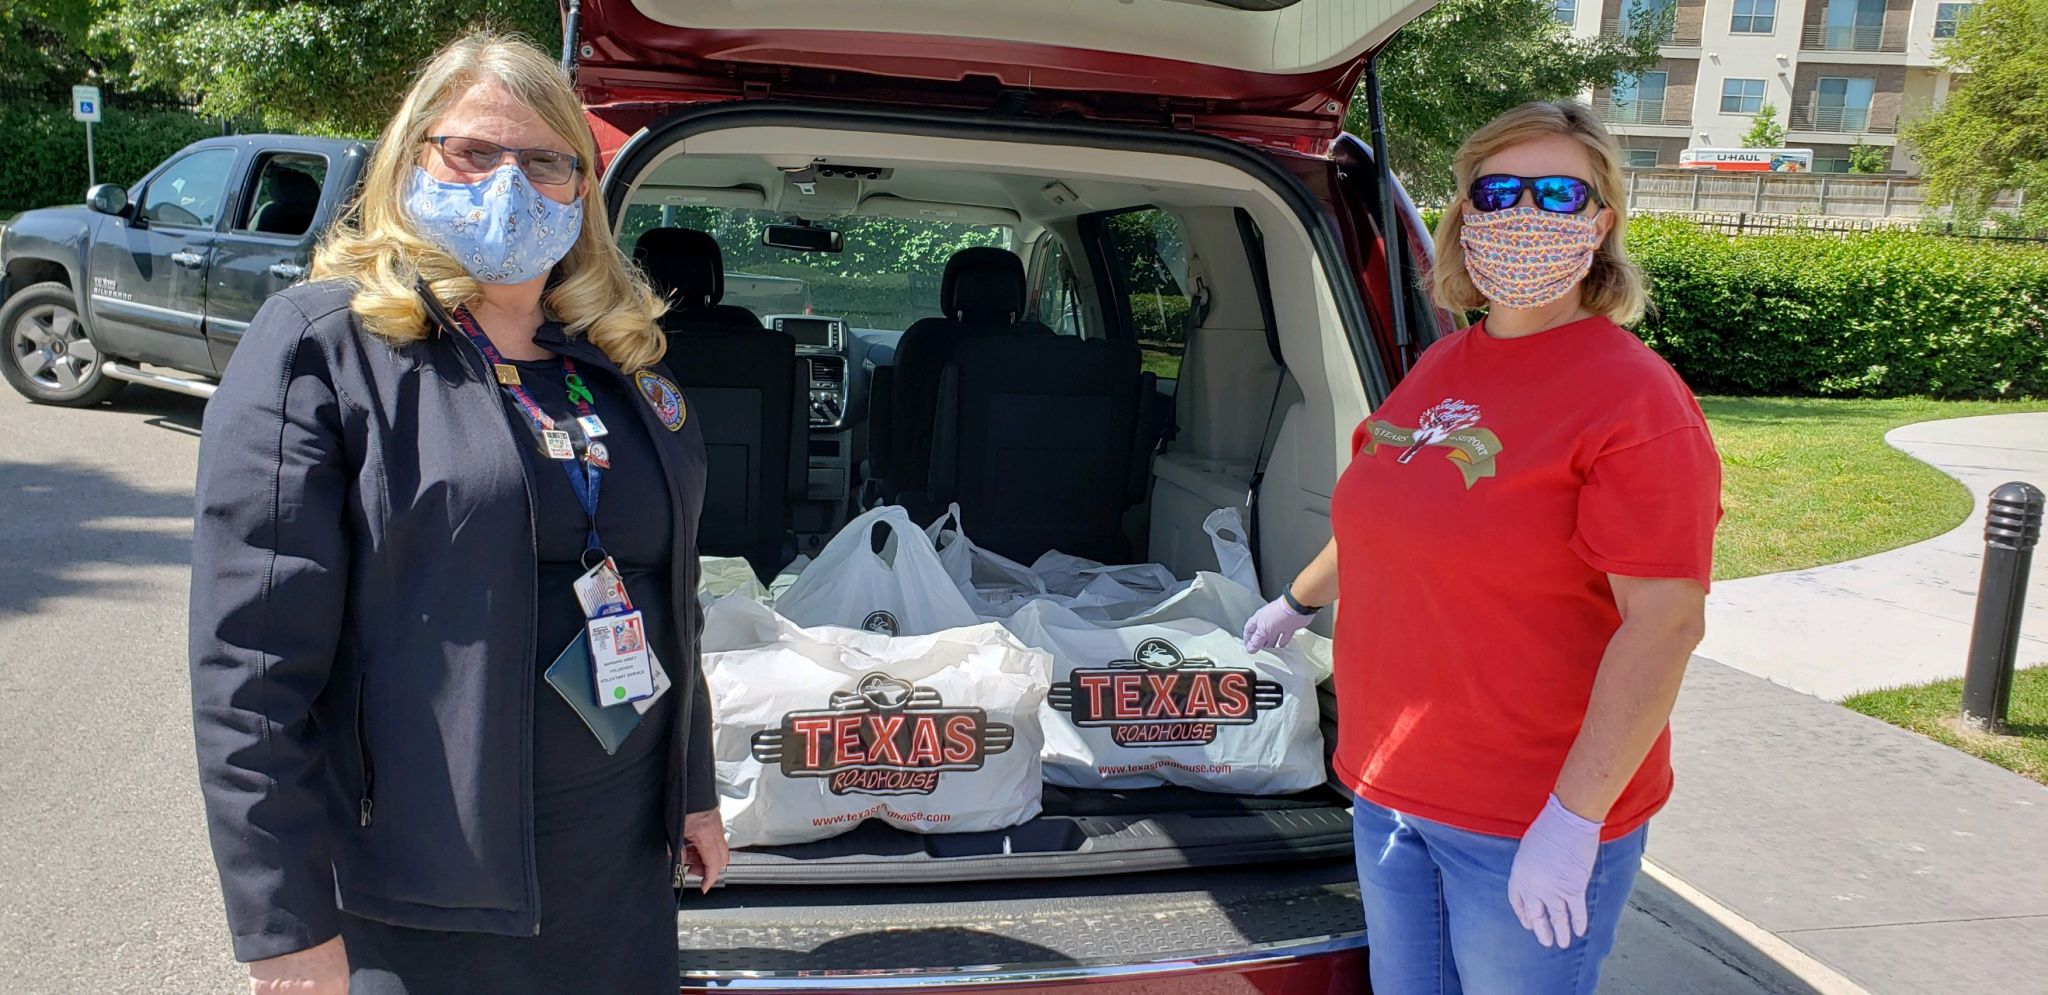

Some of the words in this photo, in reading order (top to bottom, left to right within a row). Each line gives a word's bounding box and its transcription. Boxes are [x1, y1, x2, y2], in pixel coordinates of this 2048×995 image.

[1080, 673, 1249, 718] TEXAS
[792, 715, 977, 767] TEXAS
[1116, 724, 1214, 742] ROADHOUSE
[1099, 760, 1232, 774] www.texasroadhouse.com
[833, 769, 937, 790] ROADHOUSE
